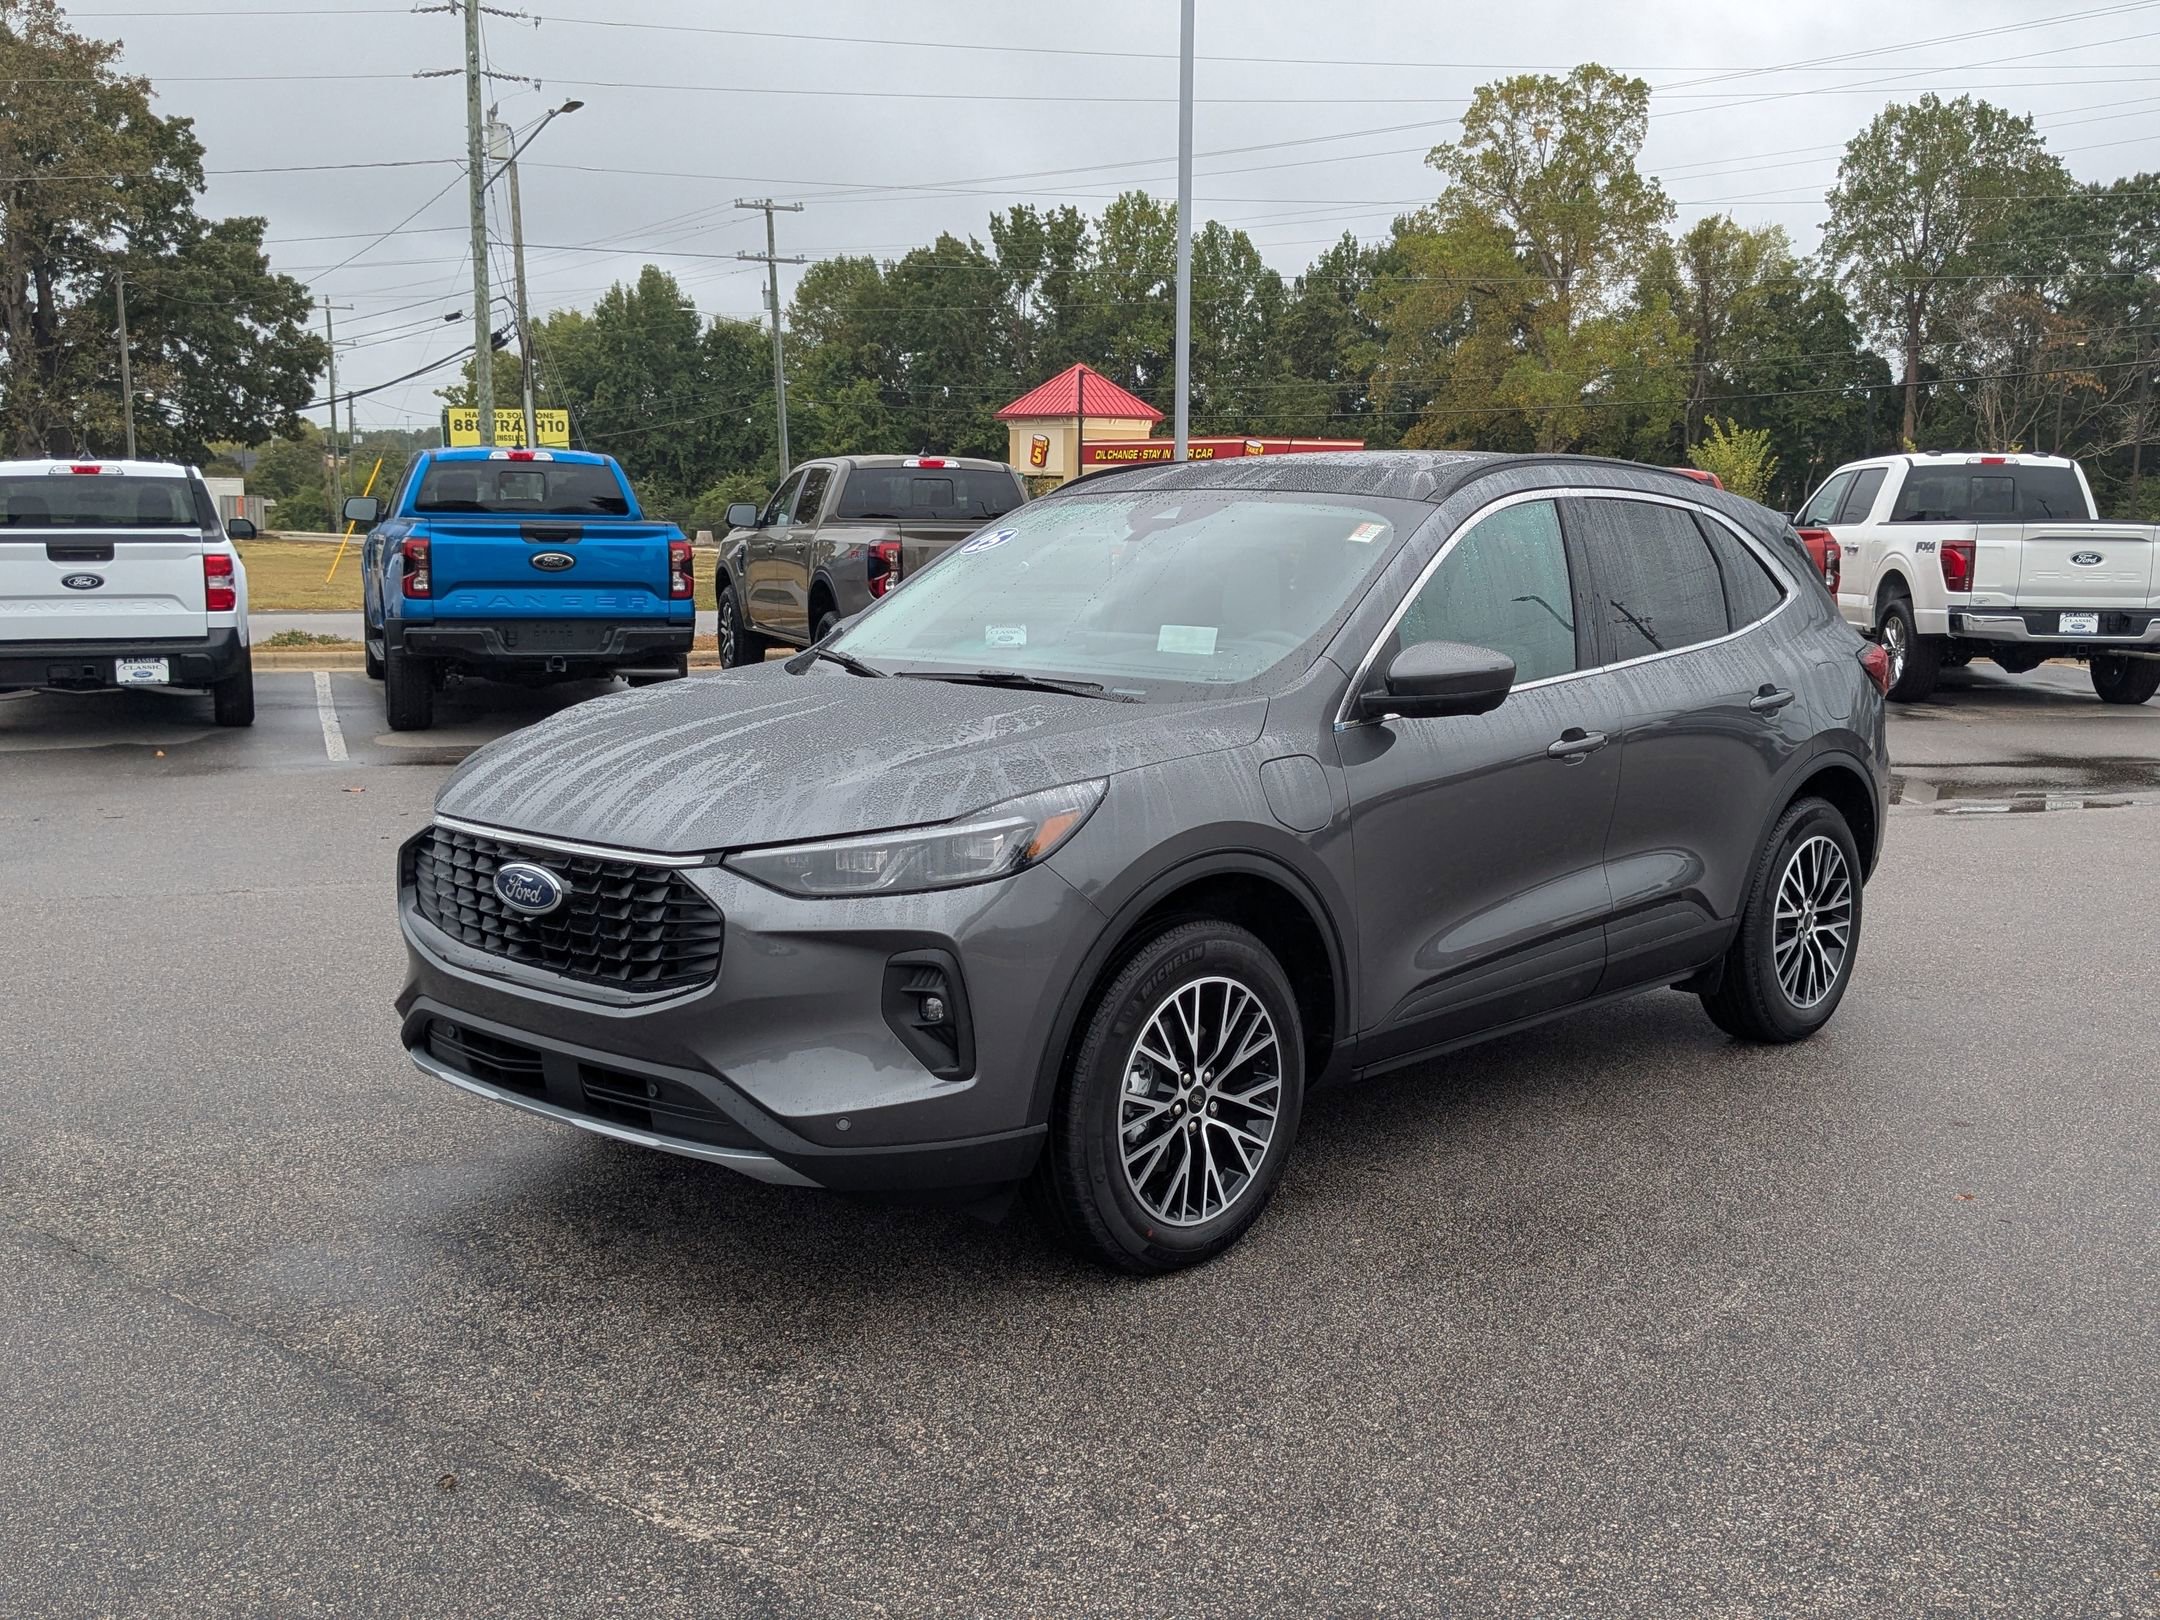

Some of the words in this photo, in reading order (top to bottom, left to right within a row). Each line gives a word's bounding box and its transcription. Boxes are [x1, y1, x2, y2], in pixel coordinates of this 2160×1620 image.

[1032, 447, 1042, 464] 5
[1095, 450, 1106, 459] OIL
[1107, 449, 1138, 459] CHANGE
[1142, 449, 1161, 459] STAY
[1162, 449, 1171, 459] IN
[1195, 448, 1213, 458] CAR
[1915, 541, 1936, 553] FX4
[455, 595, 650, 608] RANGER
[505, 873, 543, 903] Ford
[1141, 945, 1204, 999] MICHELIN
